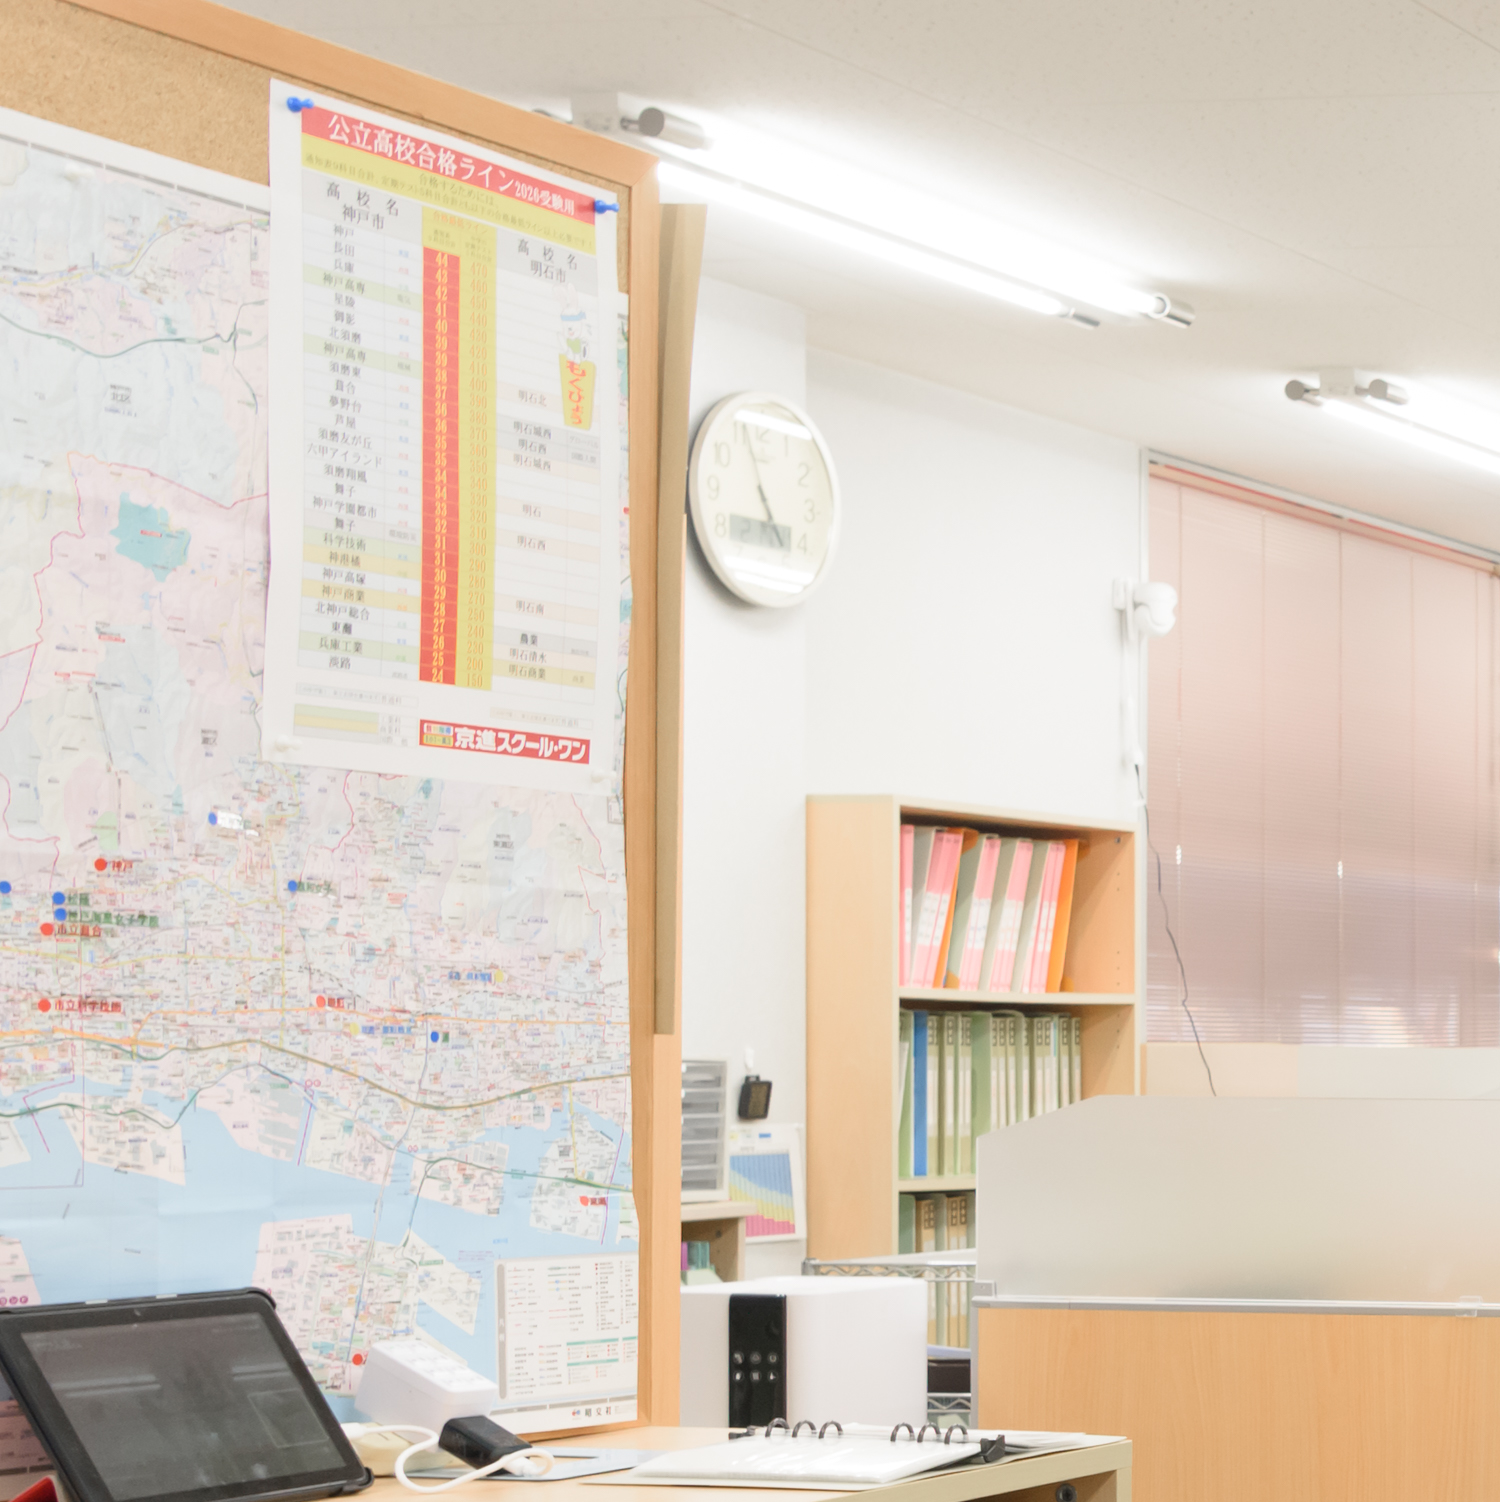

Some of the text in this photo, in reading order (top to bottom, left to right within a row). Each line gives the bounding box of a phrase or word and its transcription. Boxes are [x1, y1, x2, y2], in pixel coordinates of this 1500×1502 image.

[328, 114, 514, 192] 公立高校合格ライン
[342, 204, 385, 231] 神戸市
[334, 224, 354, 238] 神戸
[334, 241, 355, 257] 長田
[334, 259, 354, 274] 兵庫
[435, 252, 448, 267] 44
[435, 269, 448, 284] 43
[530, 260, 566, 283] 明石市
[323, 273, 365, 294] 神戸高専
[435, 285, 447, 300] 42
[435, 319, 447, 334] 40
[435, 335, 447, 351] 39
[435, 385, 447, 399] 37
[519, 390, 547, 407] 明石北
[330, 395, 361, 413] 夢野台
[435, 401, 447, 416] 36
[335, 414, 356, 429] 芦屋
[308, 443, 382, 468] 六甲アイランド
[714, 441, 730, 467] 10
[798, 462, 809, 487] 2
[335, 482, 356, 498] 舞子
[707, 475, 720, 499] 9
[523, 505, 541, 518] 明石
[804, 500, 815, 523] 3
[435, 519, 447, 533] 32
[715, 513, 726, 537] 8
[323, 532, 366, 551] 科学技術
[796, 533, 808, 554] 4
[434, 568, 446, 583] 30
[322, 585, 365, 603] 神戸商業
[434, 585, 446, 600] 29
[434, 602, 445, 616] 28
[516, 600, 544, 614] 明石南
[434, 618, 445, 633] 27
[319, 637, 363, 654] 兵庫工業
[433, 651, 443, 666] 25
[432, 668, 443, 683] 24
[454, 726, 586, 761] 京進スクール・ワン
